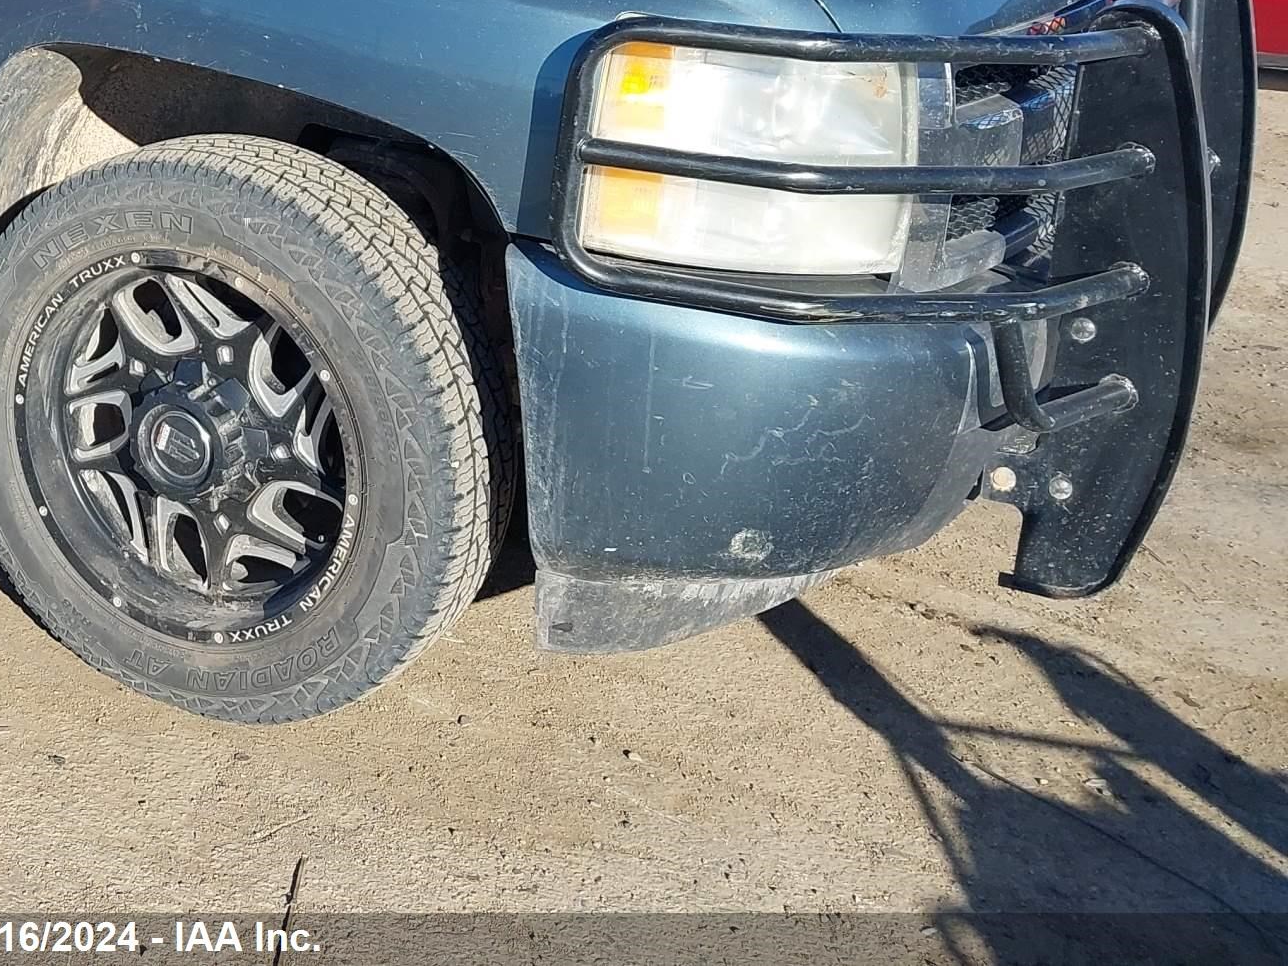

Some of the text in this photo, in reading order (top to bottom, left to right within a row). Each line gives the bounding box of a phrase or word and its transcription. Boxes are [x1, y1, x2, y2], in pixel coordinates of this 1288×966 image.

[31, 210, 194, 270] NEXEN
[17, 293, 65, 387] AMERICAN
[68, 254, 127, 289] TRUXX
[229, 512, 356, 643] AMERICAN TRUXX
[123, 648, 172, 677] AT
[186, 626, 342, 691] ROADIAN
